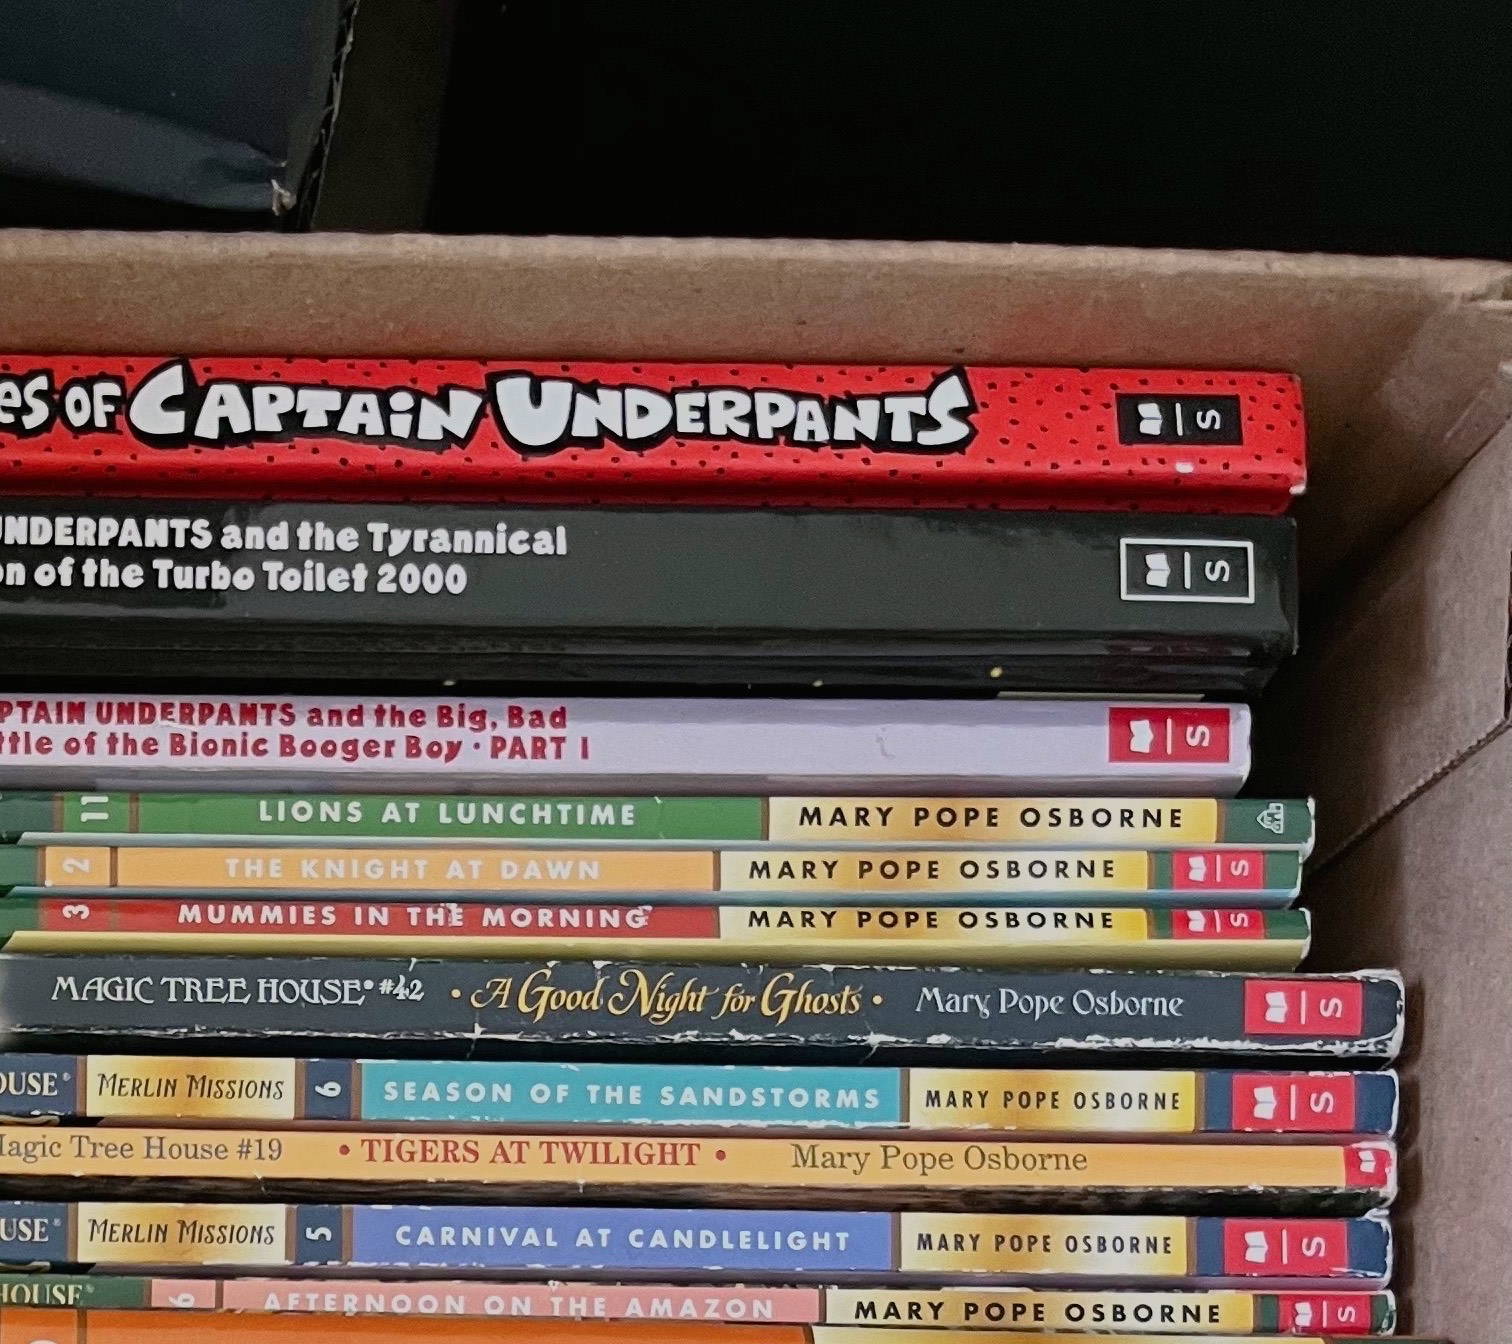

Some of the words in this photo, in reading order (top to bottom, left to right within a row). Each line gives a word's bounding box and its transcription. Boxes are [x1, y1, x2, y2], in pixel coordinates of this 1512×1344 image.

[64, 380, 122, 428] OF
[220, 521, 288, 551] and
[295, 521, 359, 554] the
[368, 523, 568, 559] Tyrannical
[34, 556, 72, 586] of
[82, 557, 142, 587] the
[153, 559, 254, 589] Turbo
[262, 560, 367, 593] Toilet
[376, 564, 468, 594] 2000
[259, 800, 362, 823] LIONS
[381, 801, 421, 824] AT
[438, 803, 635, 826] LUNCHTIME
[798, 805, 893, 829] MARY
[913, 805, 1004, 829] POPE
[1021, 806, 1184, 829] OSBORNE
[69, 1135, 134, 1159] Tree
[143, 1136, 228, 1160] House
[238, 1137, 283, 1162] #19
[361, 1139, 479, 1165] TIGERS
[489, 1141, 529, 1164] AT
[540, 1142, 700, 1167] TWILIGHT
[792, 1145, 871, 1176] Mary
[882, 1146, 954, 1176] Pope
[964, 1148, 1087, 1171] Osborne
